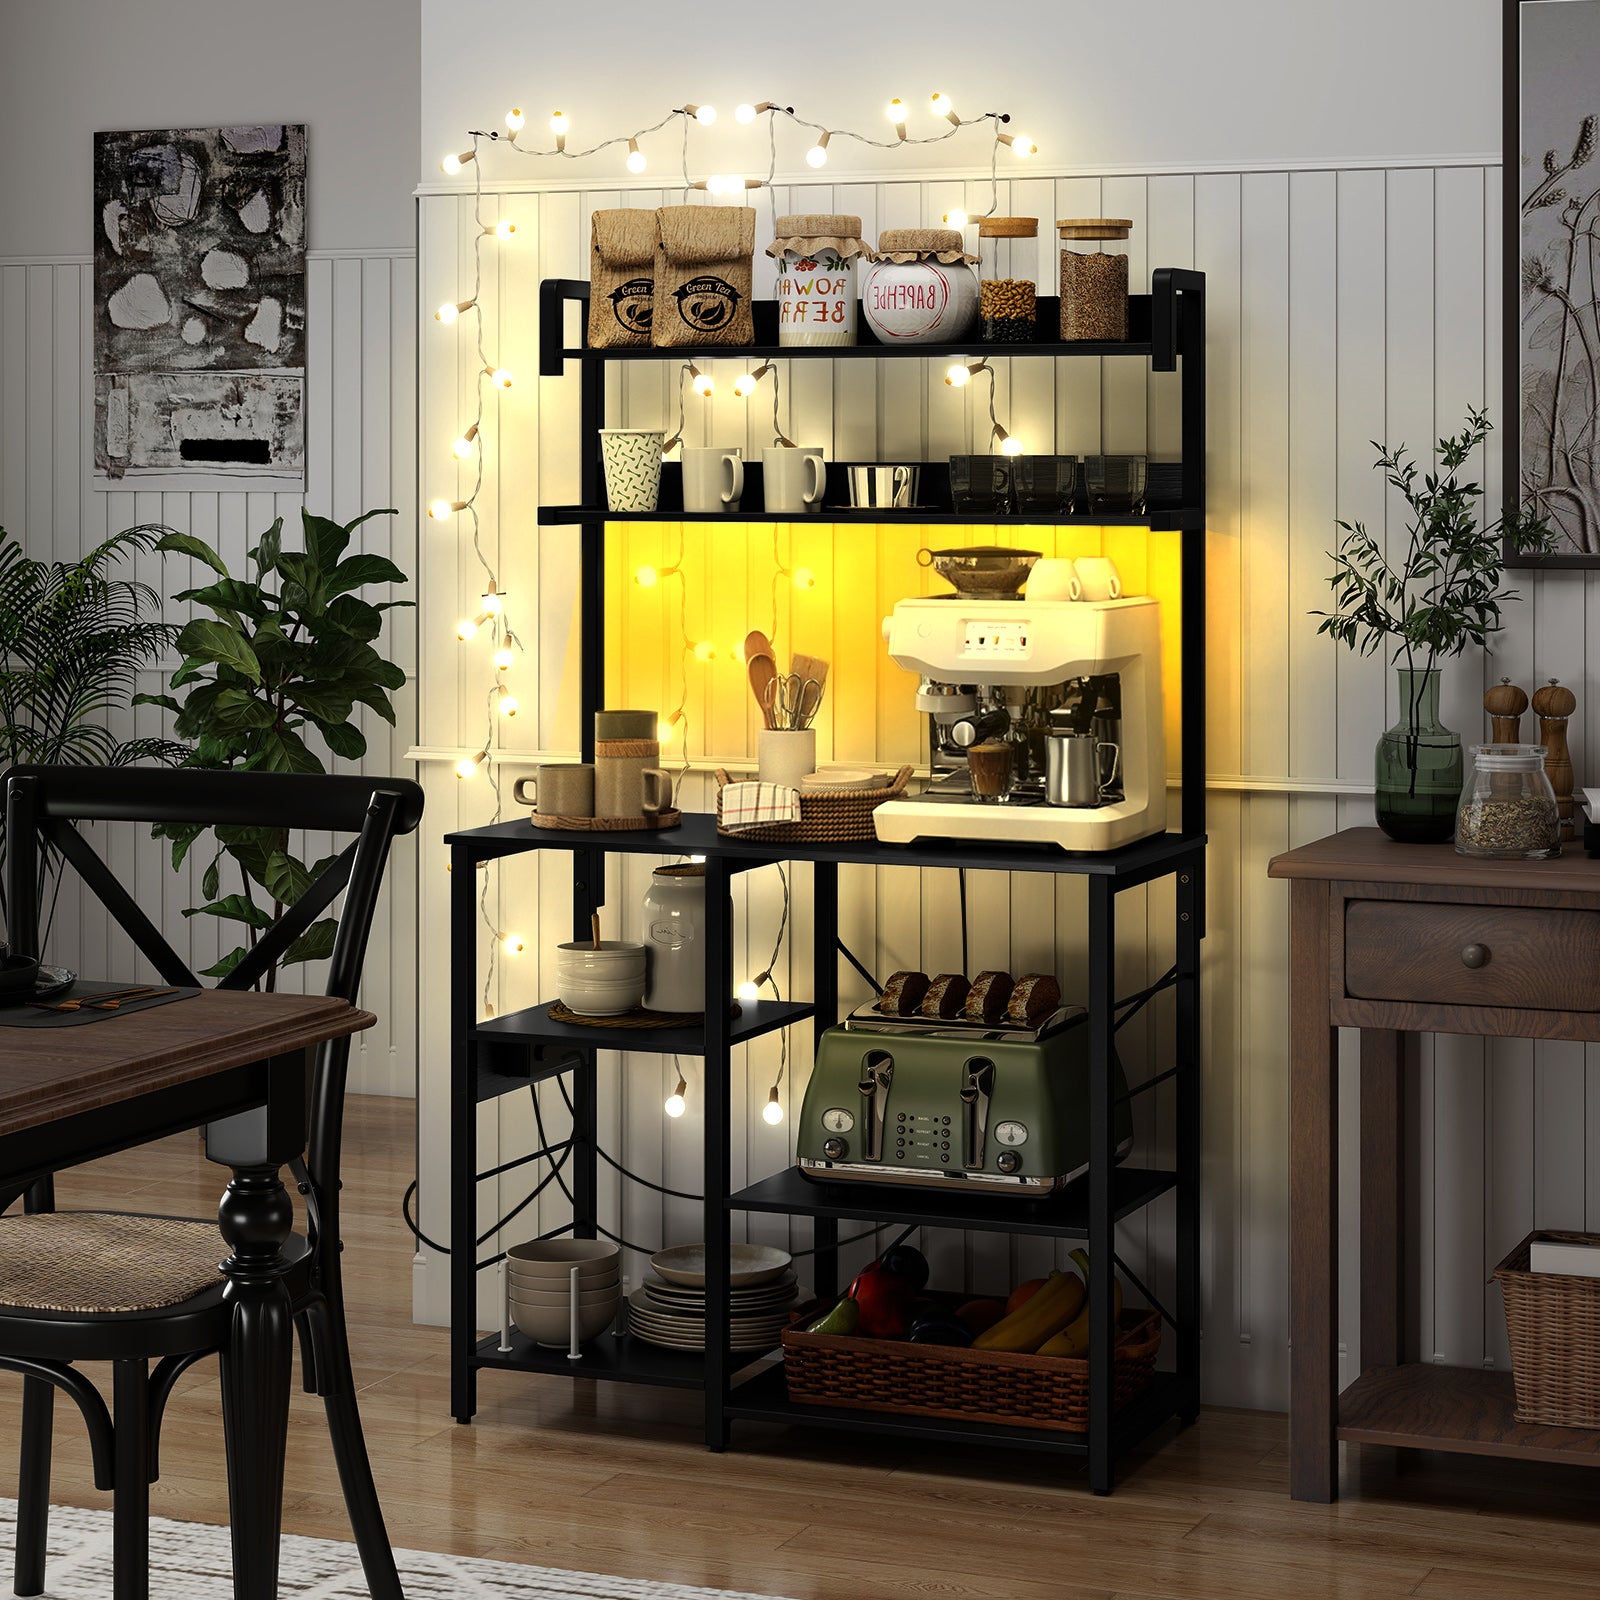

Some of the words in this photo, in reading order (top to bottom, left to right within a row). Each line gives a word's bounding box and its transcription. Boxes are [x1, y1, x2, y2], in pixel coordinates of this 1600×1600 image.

[621, 285, 647, 296] Green
[686, 283, 712, 294] Green
[715, 282, 731, 295] Tea
